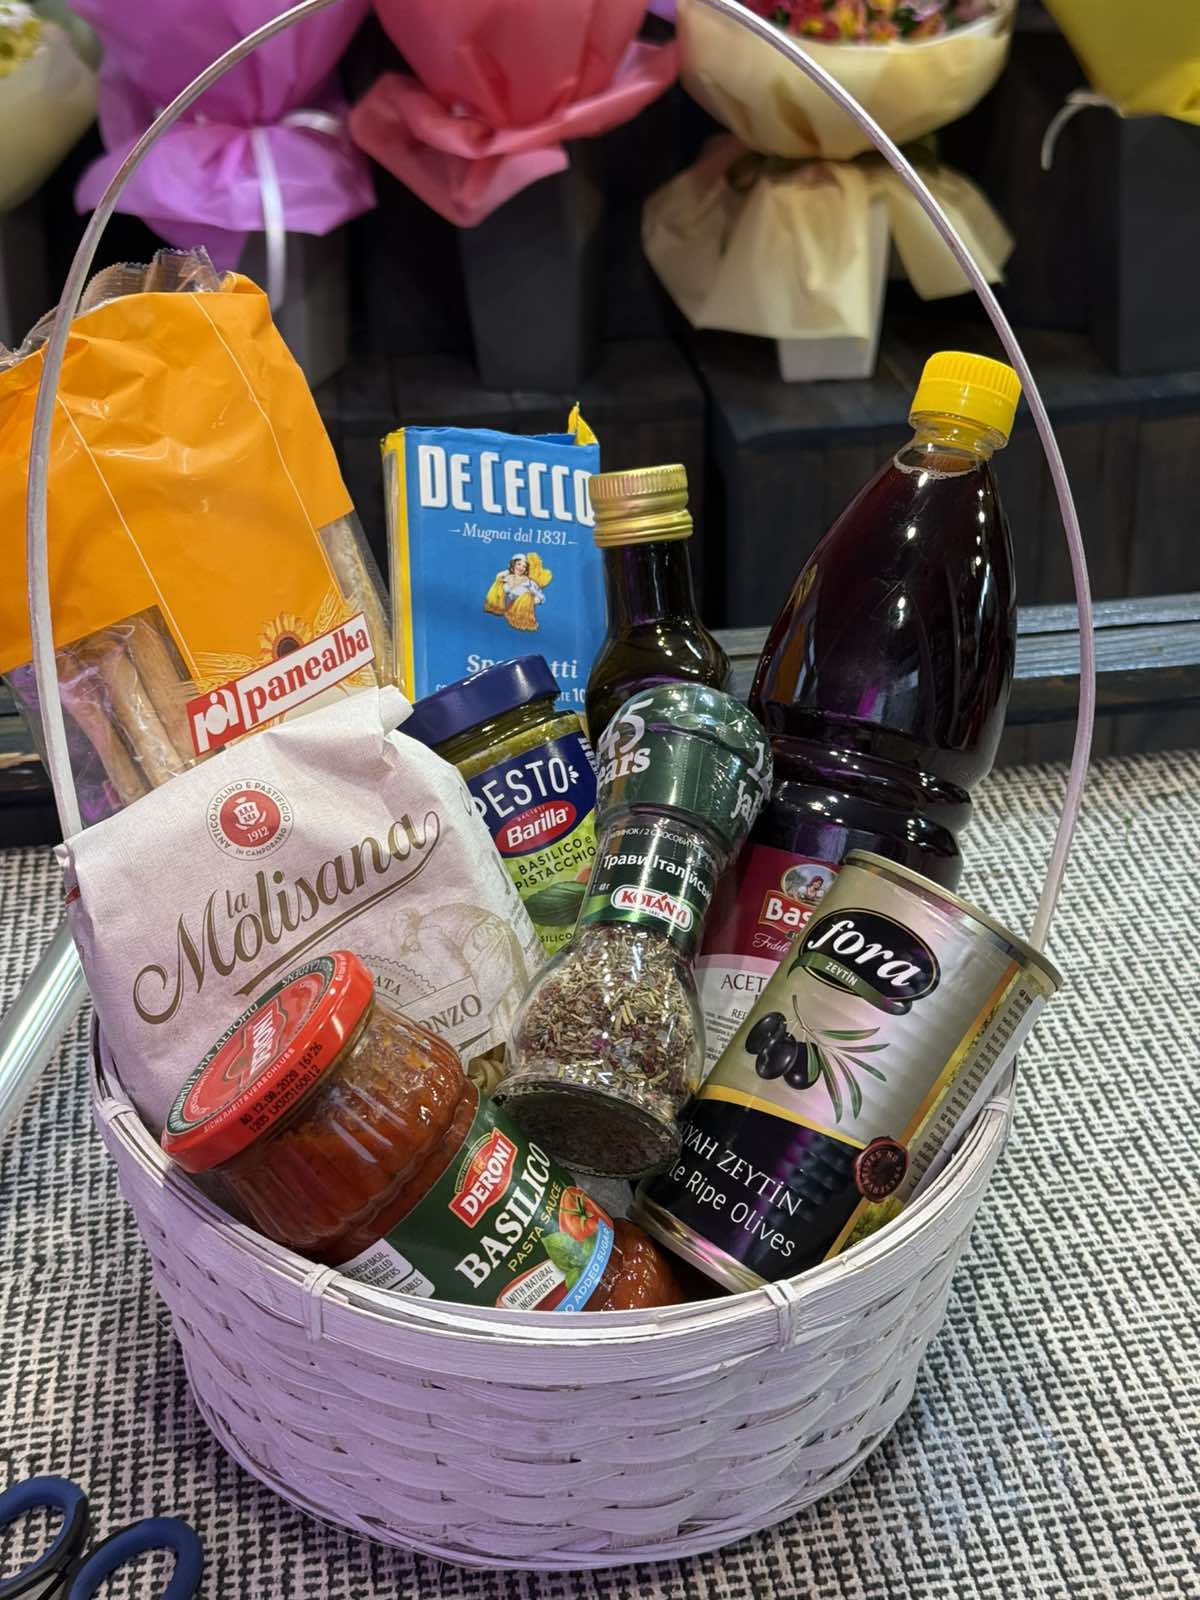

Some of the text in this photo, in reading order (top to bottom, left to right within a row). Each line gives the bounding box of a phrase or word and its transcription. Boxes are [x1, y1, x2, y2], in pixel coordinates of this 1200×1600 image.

[417, 444, 597, 528] DE CECCO
[462, 522, 567, 546] Mugnai dal 1831
[242, 626, 369, 724] panealba
[466, 654, 578, 679] Sptti
[598, 747, 651, 787] ears
[210, 781, 291, 849] ANTICO MOLINO E PASTIFICIO
[247, 826, 270, 842] 1912
[506, 807, 568, 849] Barilla
[515, 845, 597, 892] PISTACCHIO
[518, 835, 593, 875] BASILICO e
[604, 854, 647, 870] Трави
[133, 810, 440, 1025] Molisana
[226, 889, 249, 918] la
[765, 898, 813, 928] Bas
[540, 932, 573, 943] SILICO
[807, 920, 922, 987] fora
[721, 974, 768, 993] ACET
[825, 961, 858, 987] ZEYTİN
[419, 994, 482, 1033] ONZO
[460, 1138, 513, 1217] DERONI
[717, 1150, 803, 1217] ZEYTİN
[454, 1142, 550, 1288] BASILICO
[508, 1182, 561, 1272] PASTA SAUCE
[686, 1170, 727, 1211] Ripe
[730, 1203, 796, 1257] Olives
[368, 1260, 393, 1277] GRILLED
[506, 1265, 554, 1305] WITH NATURAL
[575, 1264, 600, 1303] ADDED
[597, 1228, 611, 1264] SUGAR
[518, 1276, 556, 1310] INGREDIENTS
